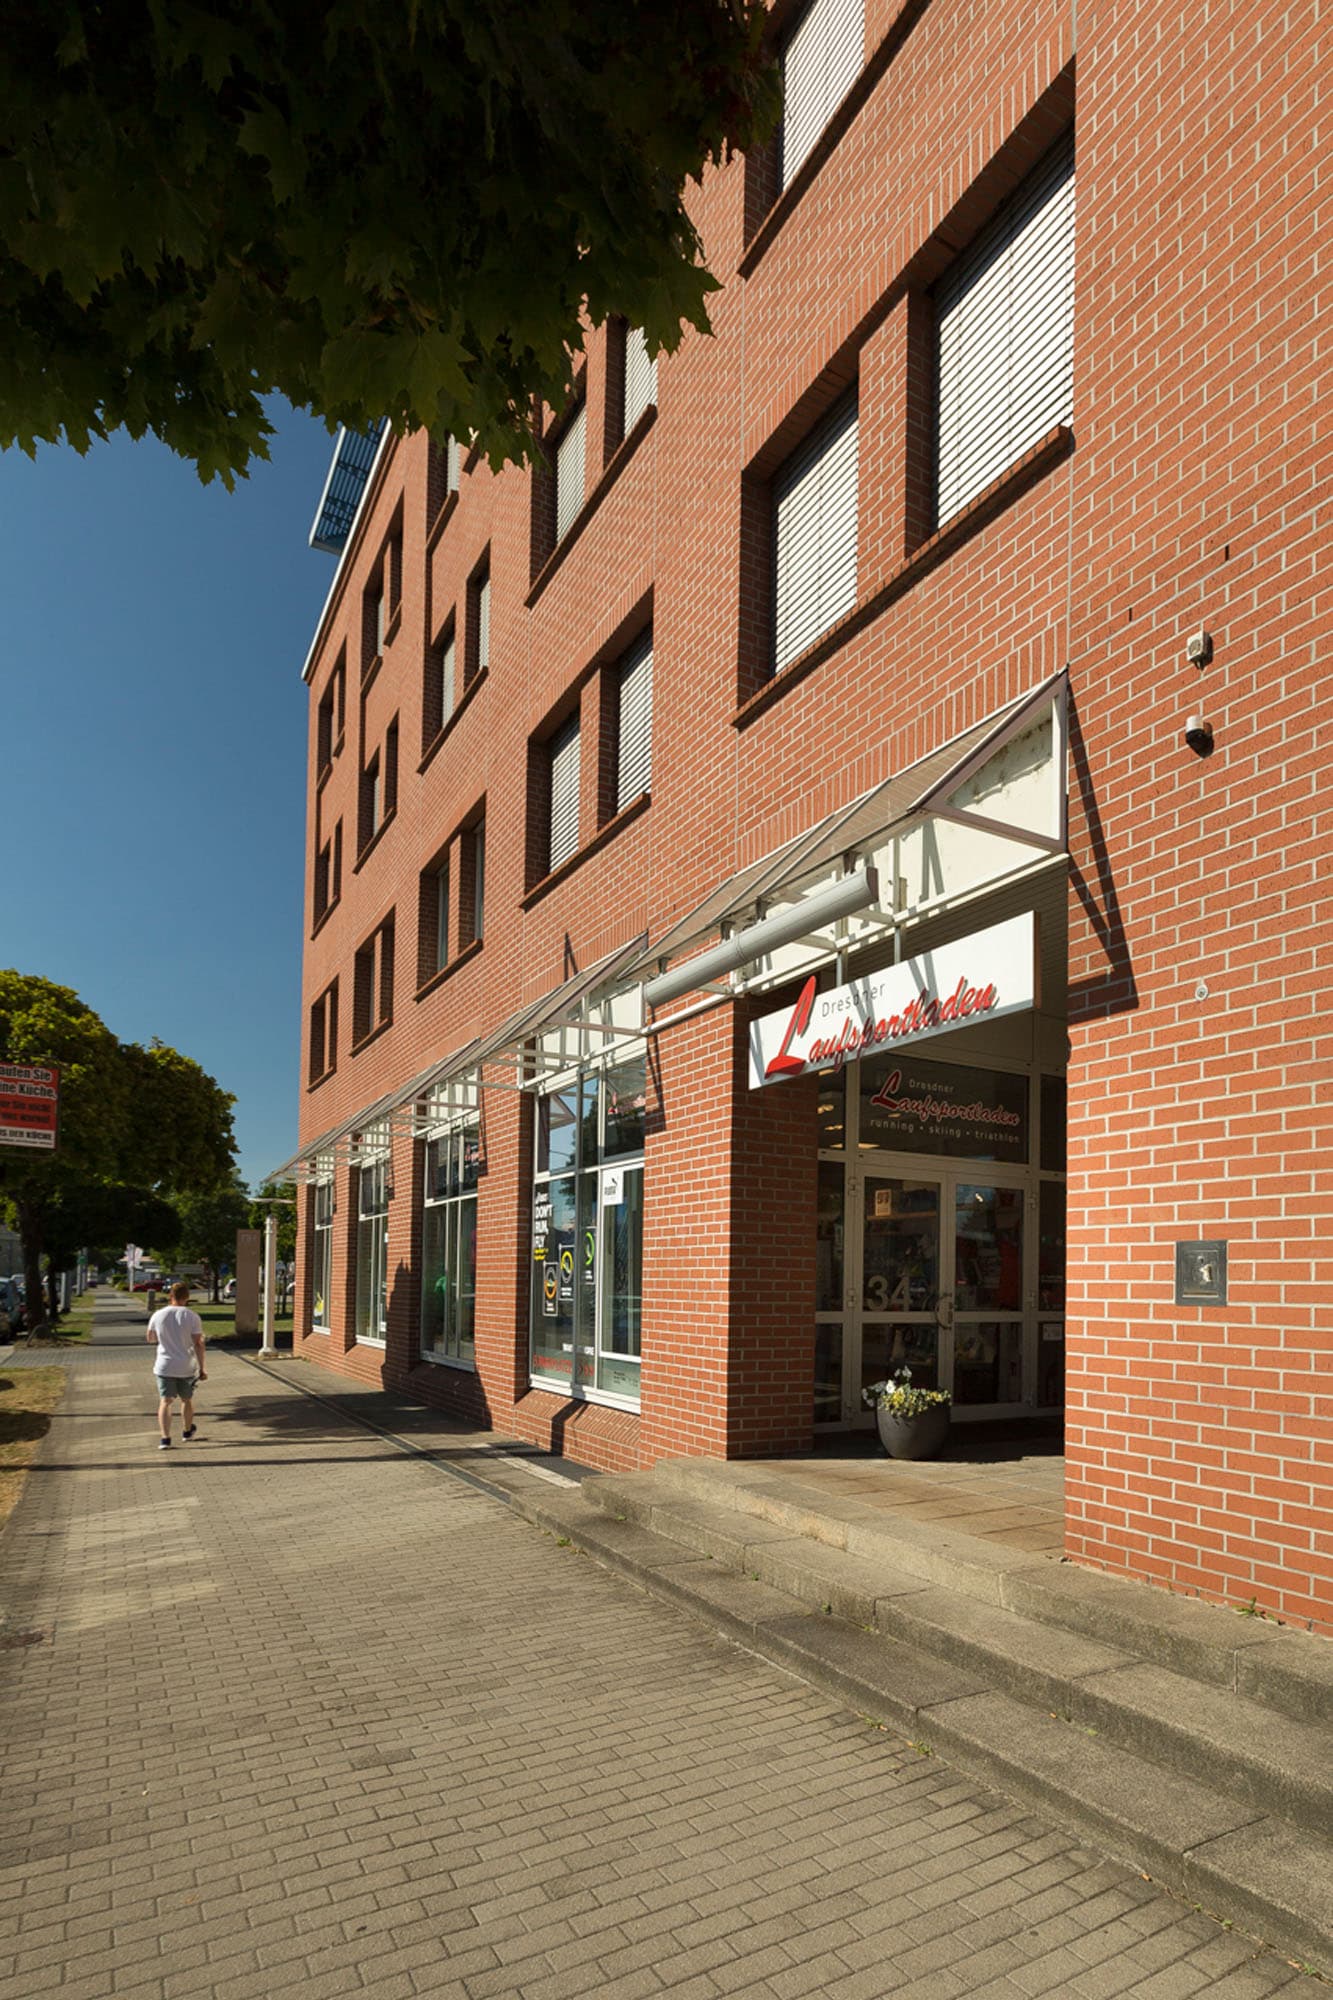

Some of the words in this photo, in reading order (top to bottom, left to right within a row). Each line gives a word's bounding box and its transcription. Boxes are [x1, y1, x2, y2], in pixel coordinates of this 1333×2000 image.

[821, 982, 887, 1017] Dresdner
[764, 975, 999, 1079] Laufsportladen
[870, 1069, 1021, 1126] Laufsportladen
[909, 1078, 955, 1093] Dresdner
[870, 1119, 915, 1133] running
[928, 1126, 962, 1139] skiing
[975, 1130, 1021, 1143] triathlon
[866, 1275, 913, 1312] 34
